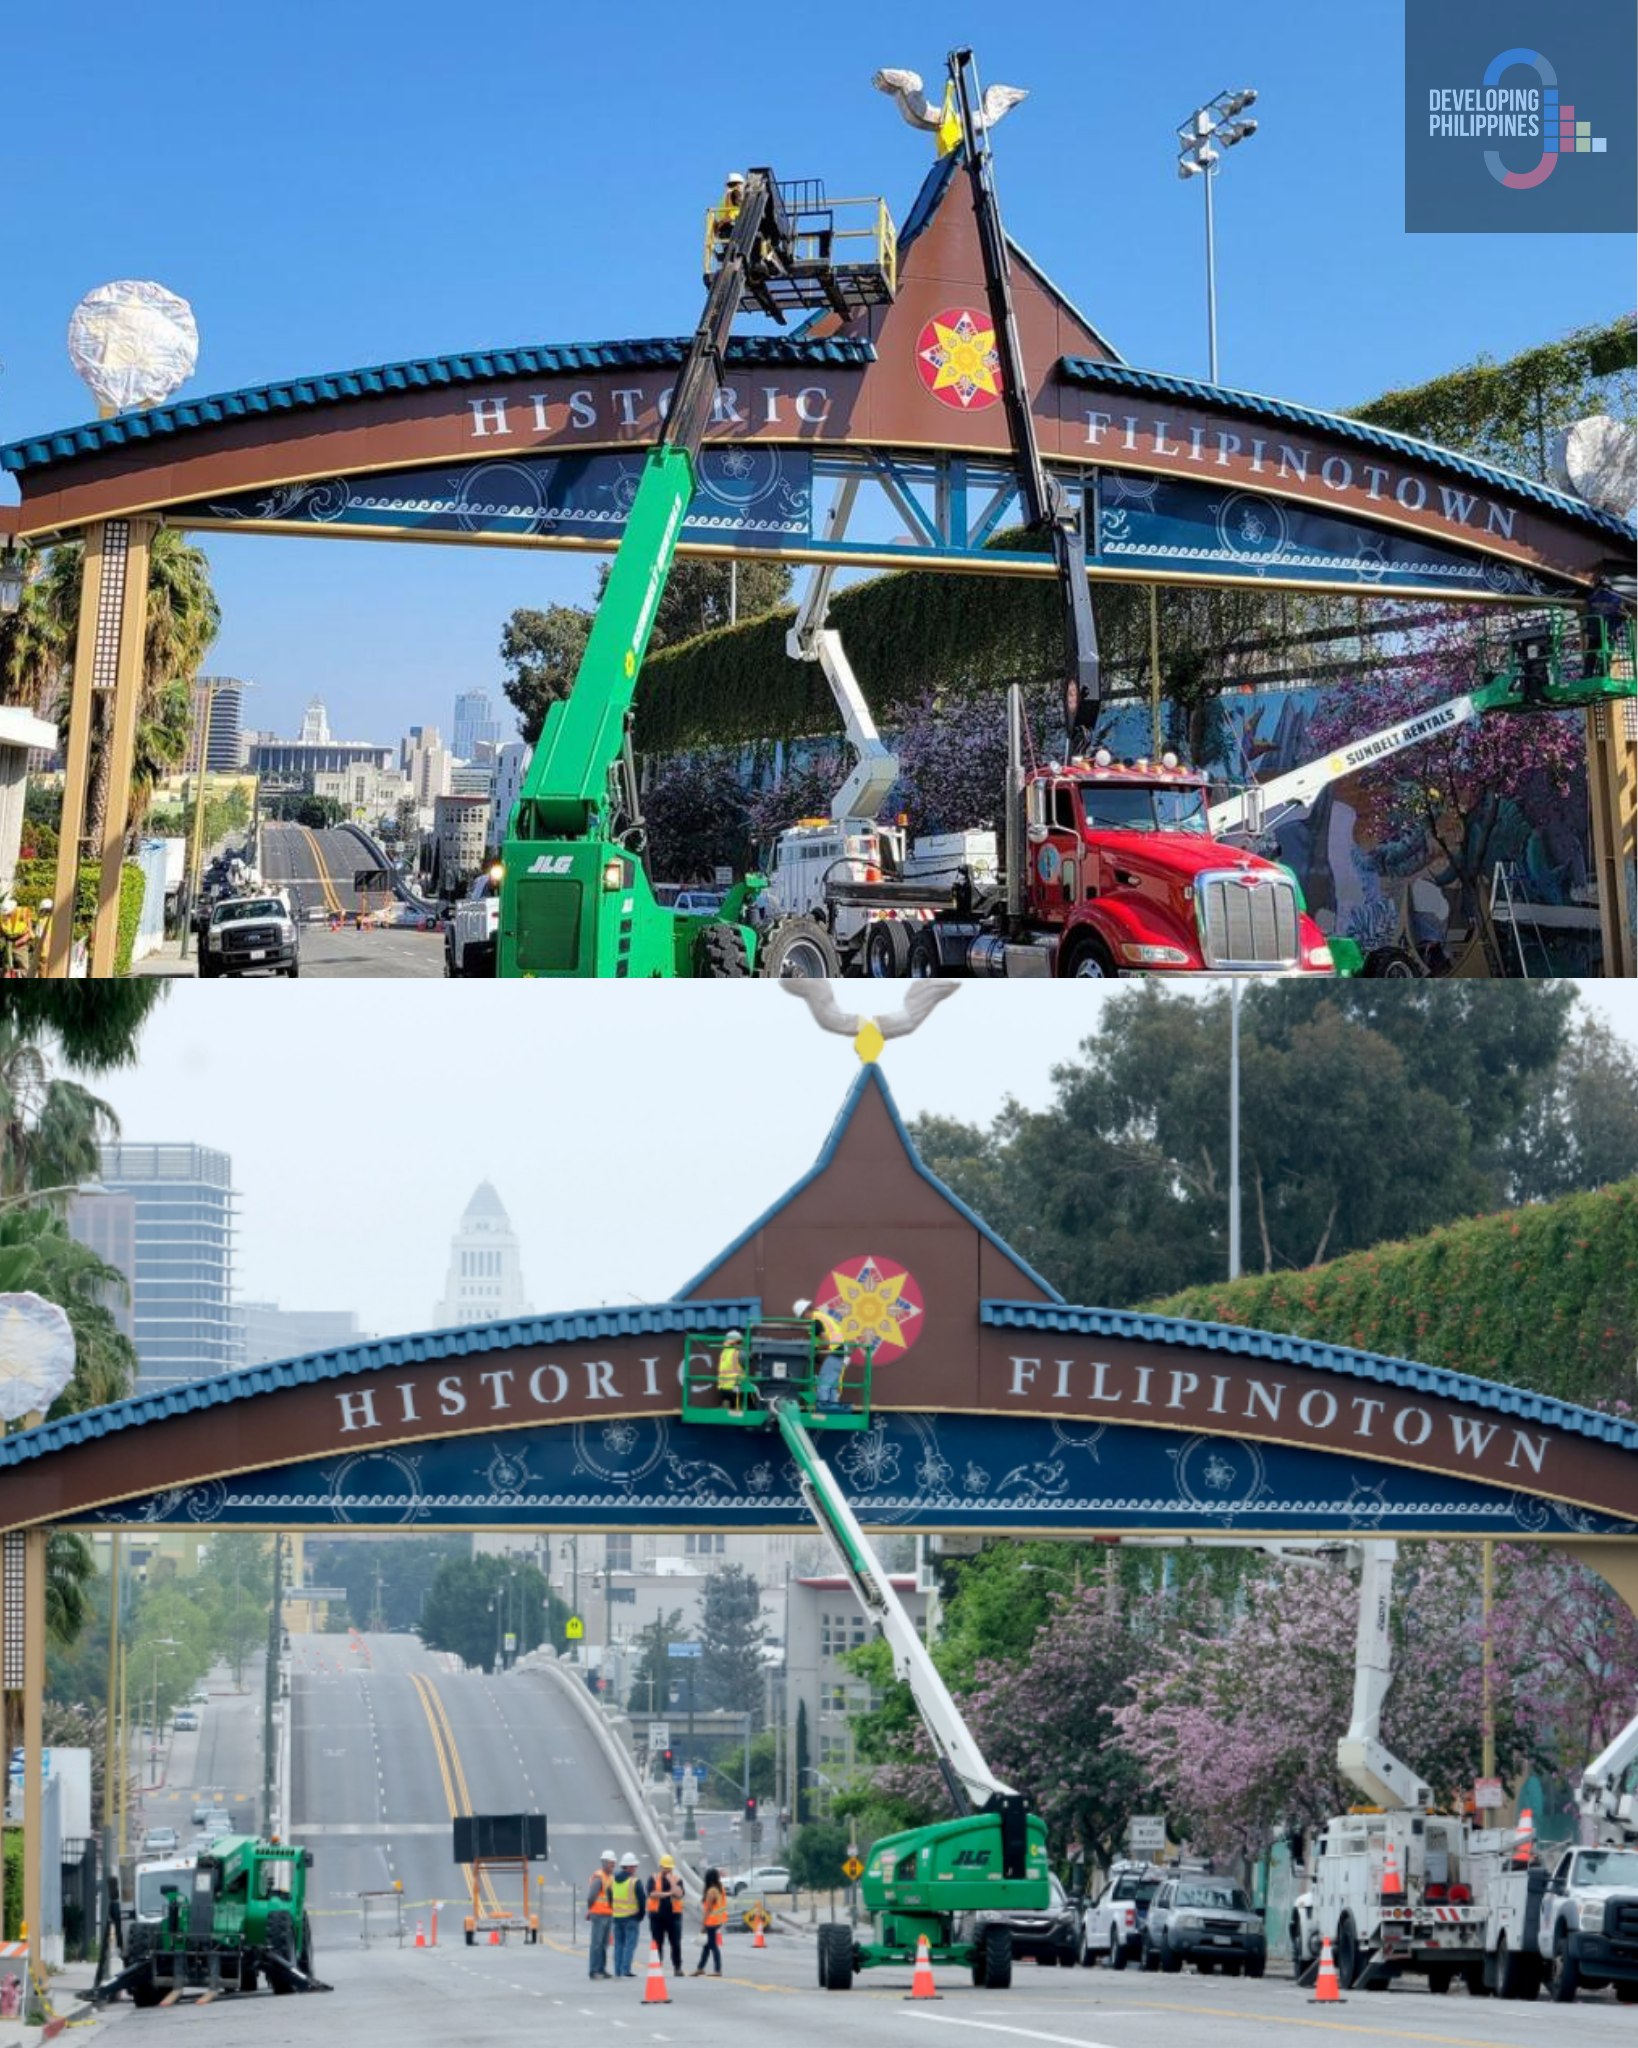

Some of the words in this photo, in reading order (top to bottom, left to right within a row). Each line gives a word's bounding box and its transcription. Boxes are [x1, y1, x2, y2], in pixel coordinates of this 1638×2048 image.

[1083, 410, 1518, 539] FILIPINOTOWN
[1345, 732, 1401, 767] SUNBELT
[1402, 708, 1456, 741] RENTALS
[527, 855, 574, 874] JLG
[336, 1352, 713, 1432] HISTORIC
[1008, 1356, 1552, 1474] FILIPINOTOWN
[952, 1849, 992, 1866] JLG
